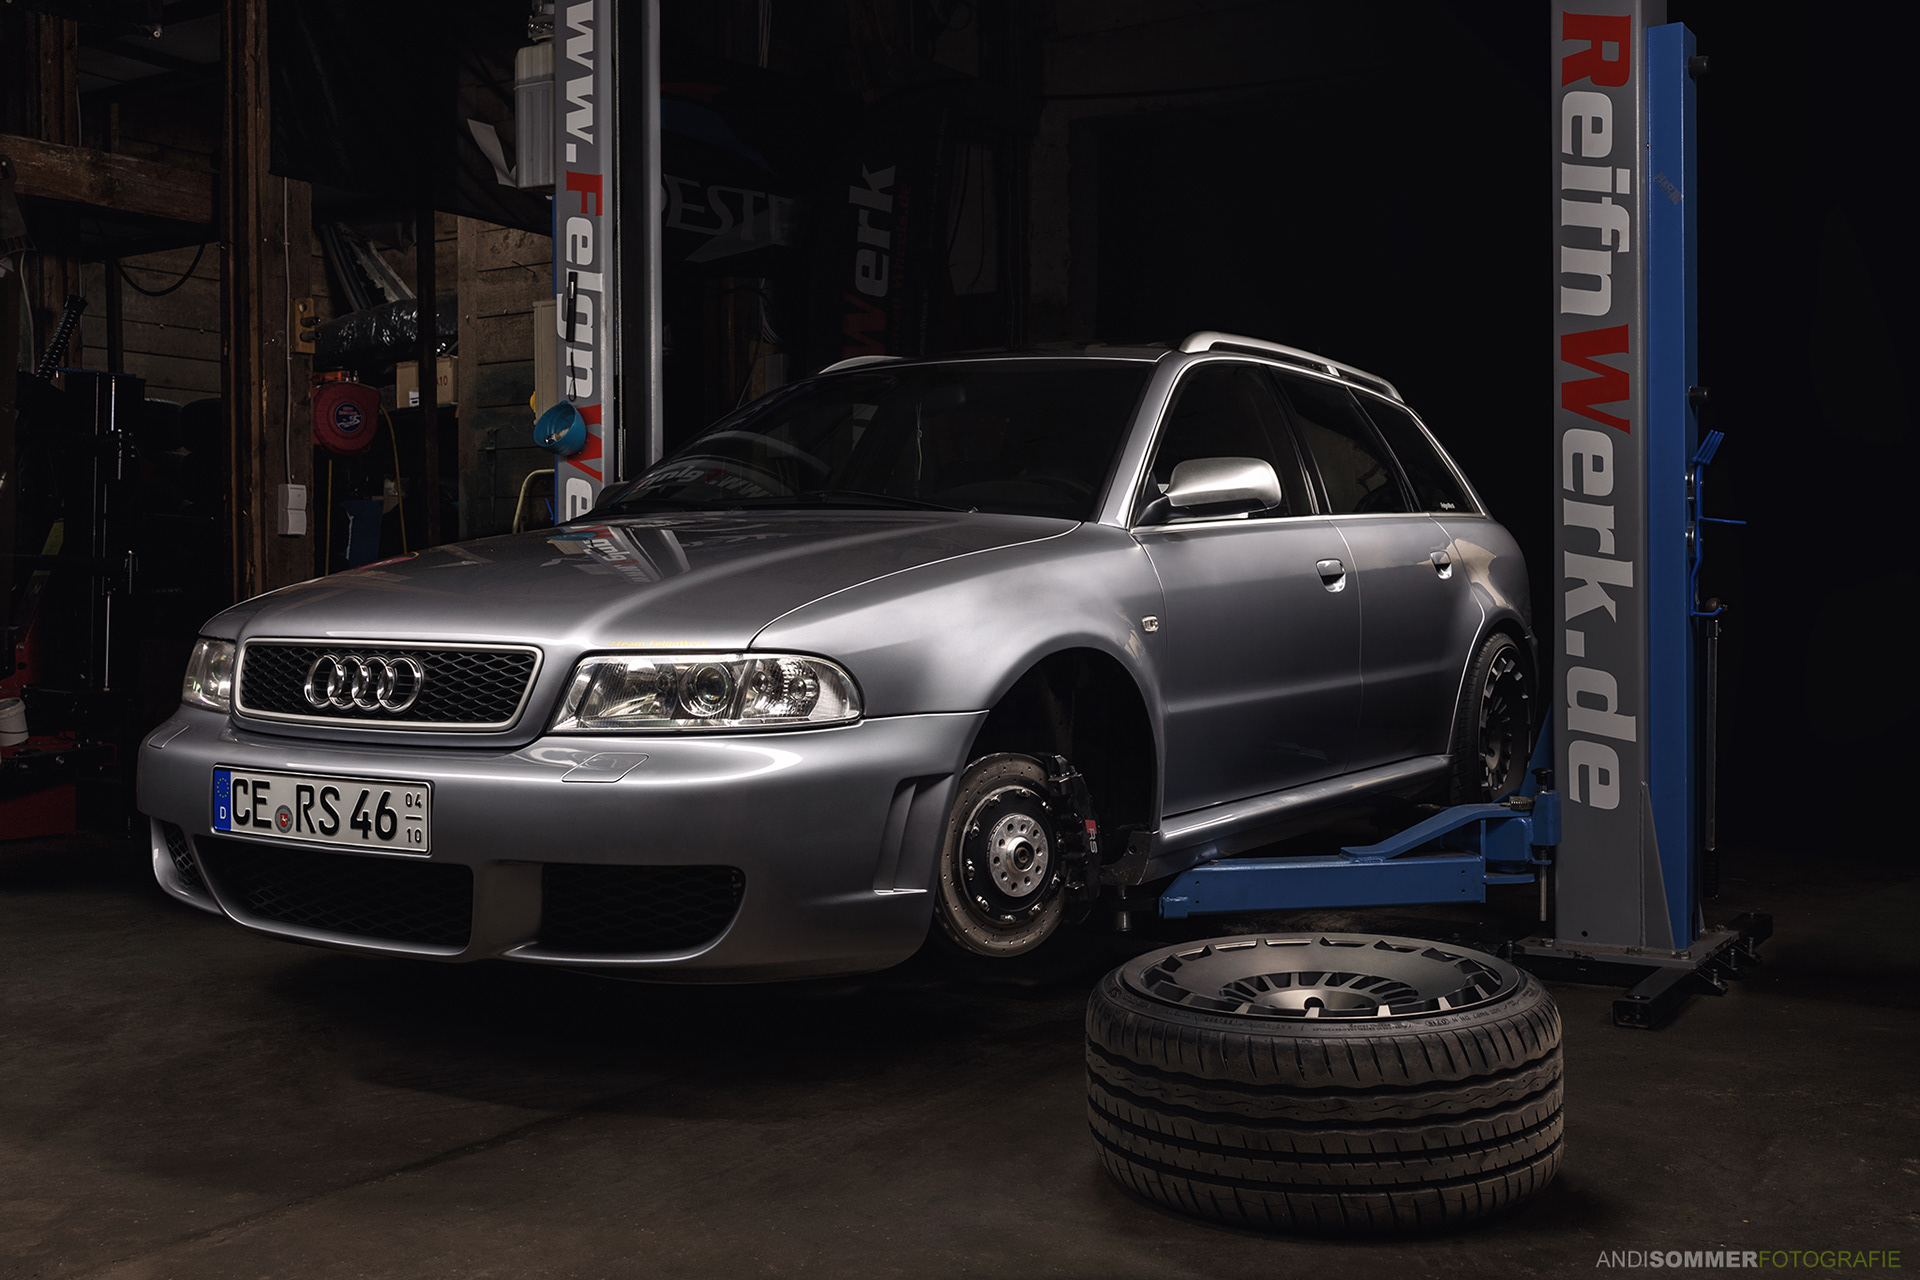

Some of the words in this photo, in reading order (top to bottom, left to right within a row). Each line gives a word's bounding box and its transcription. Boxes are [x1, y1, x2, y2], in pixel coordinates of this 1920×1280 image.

[1560, 11, 1637, 811] ReifnWerk.de
[405, 792, 422, 808] 04
[219, 805, 227, 820] D
[231, 778, 272, 828] CE
[296, 784, 341, 836] RS
[350, 789, 397, 841] 46
[406, 828, 422, 843] 10
